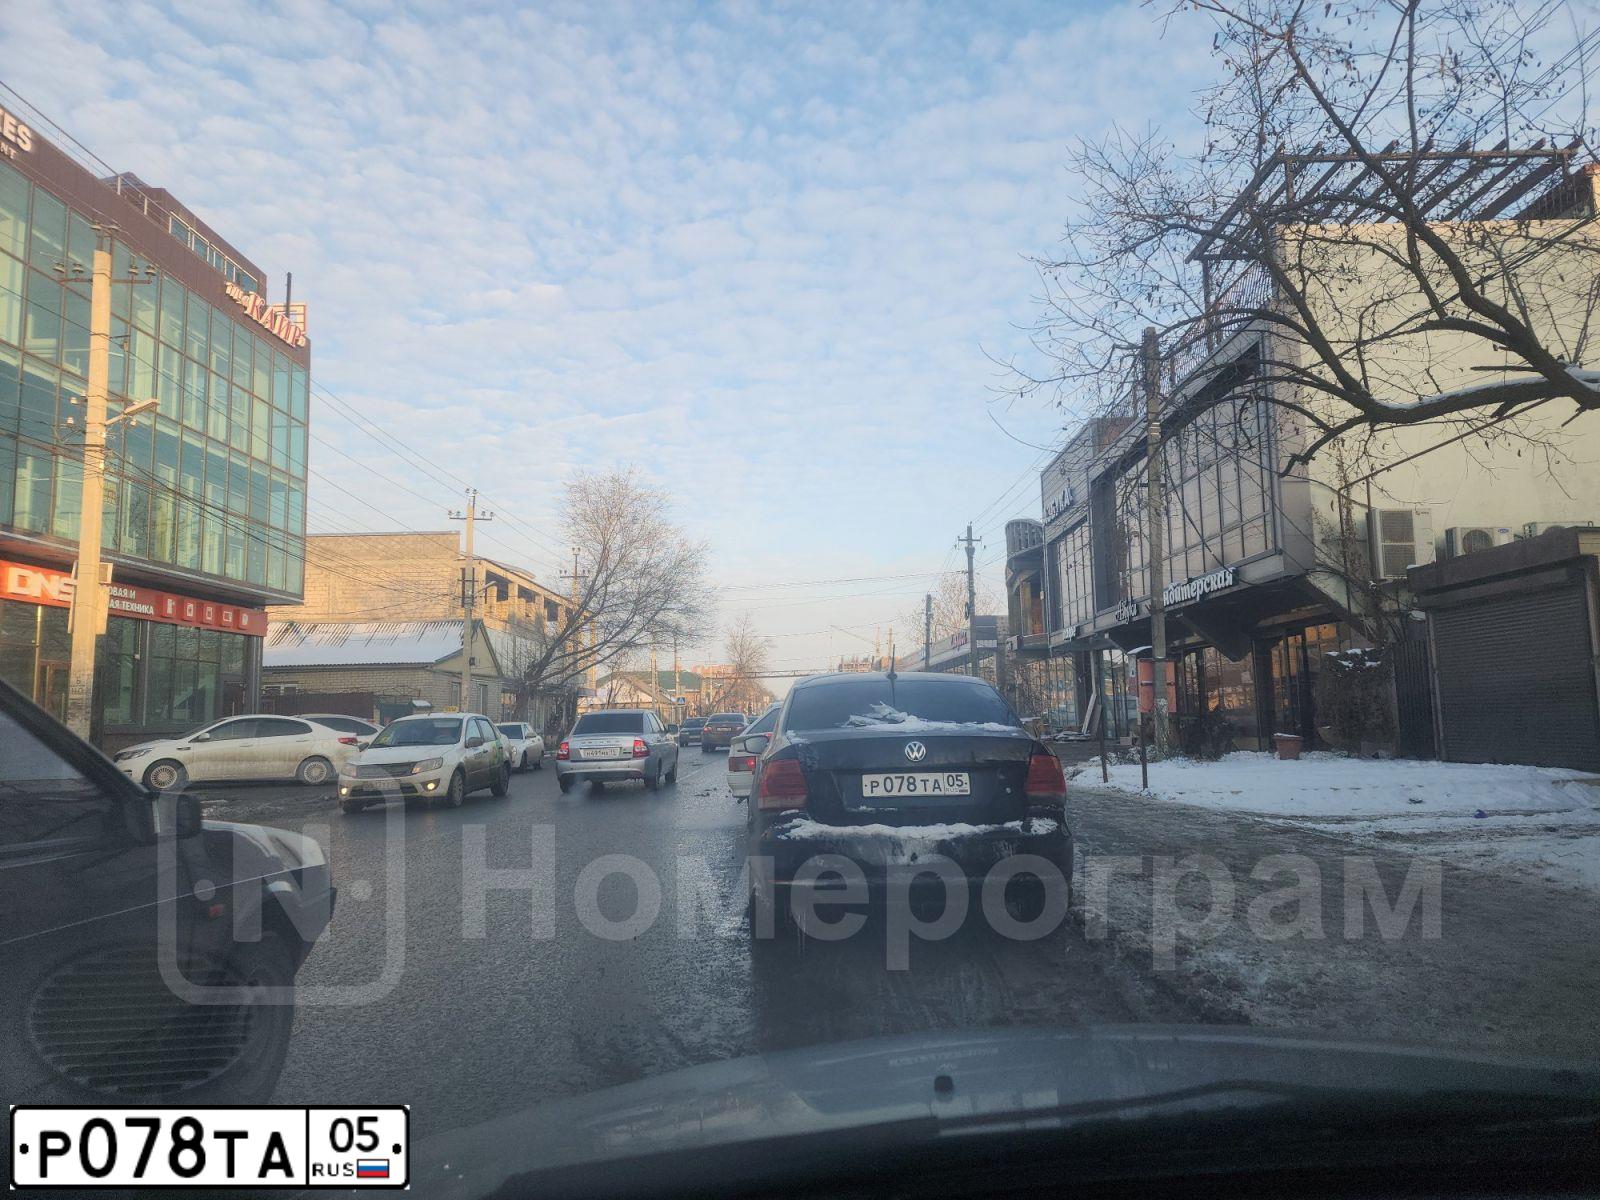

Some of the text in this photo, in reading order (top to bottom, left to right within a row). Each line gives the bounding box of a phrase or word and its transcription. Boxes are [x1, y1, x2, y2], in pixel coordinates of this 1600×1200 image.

[7, 566, 78, 602] DNS
[1163, 567, 1236, 607] ндитерская
[107, 585, 127, 599] ОВАЯ
[122, 600, 154, 615] ТЕХНИКА
[946, 774, 964, 787] 05
